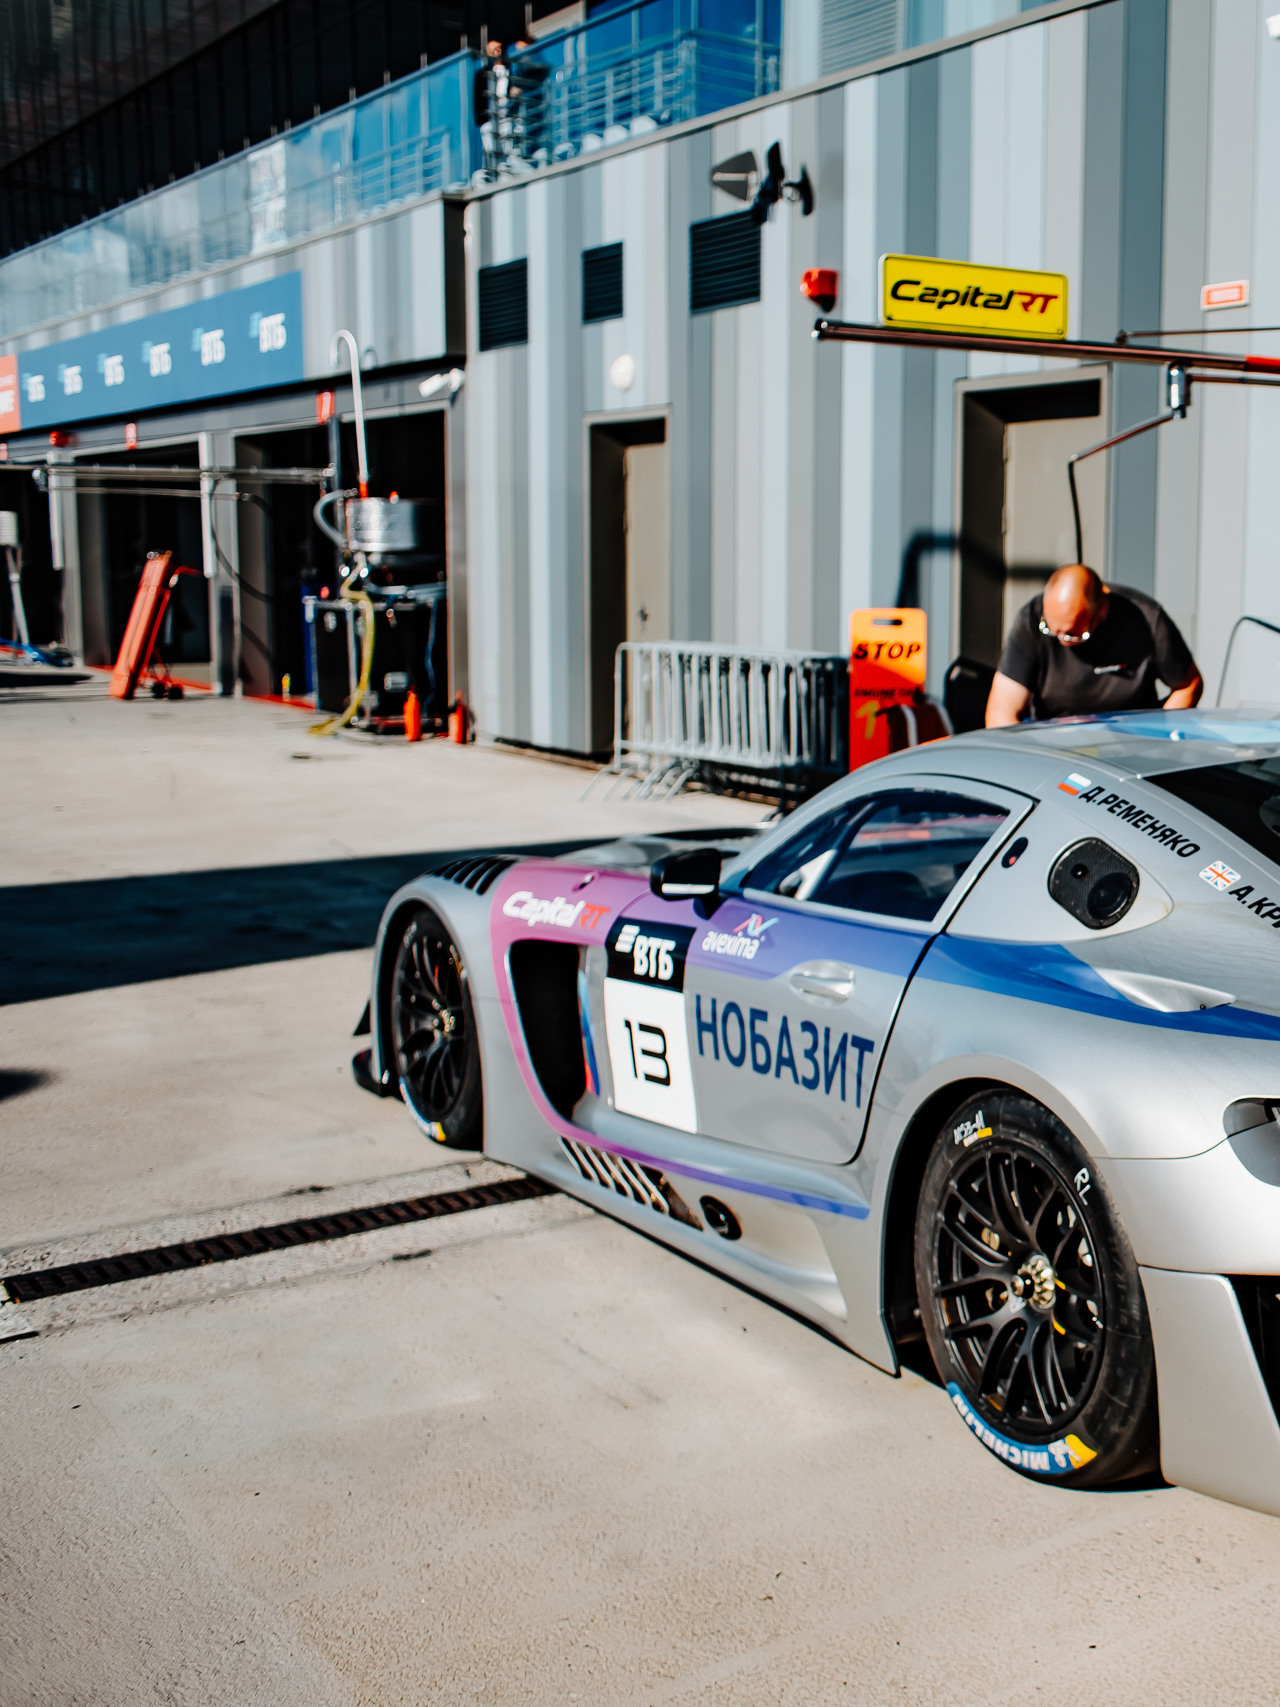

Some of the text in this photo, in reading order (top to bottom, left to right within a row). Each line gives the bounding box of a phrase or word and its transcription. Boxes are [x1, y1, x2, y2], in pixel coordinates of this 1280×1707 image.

[854, 642, 921, 660] STOP
[633, 936, 676, 981] ВТБ
[624, 1019, 672, 1087] 13
[696, 994, 875, 1109] НОБАЗИТ
[1074, 1167, 1091, 1206] RL
[952, 1393, 1051, 1471] MICHELIN
